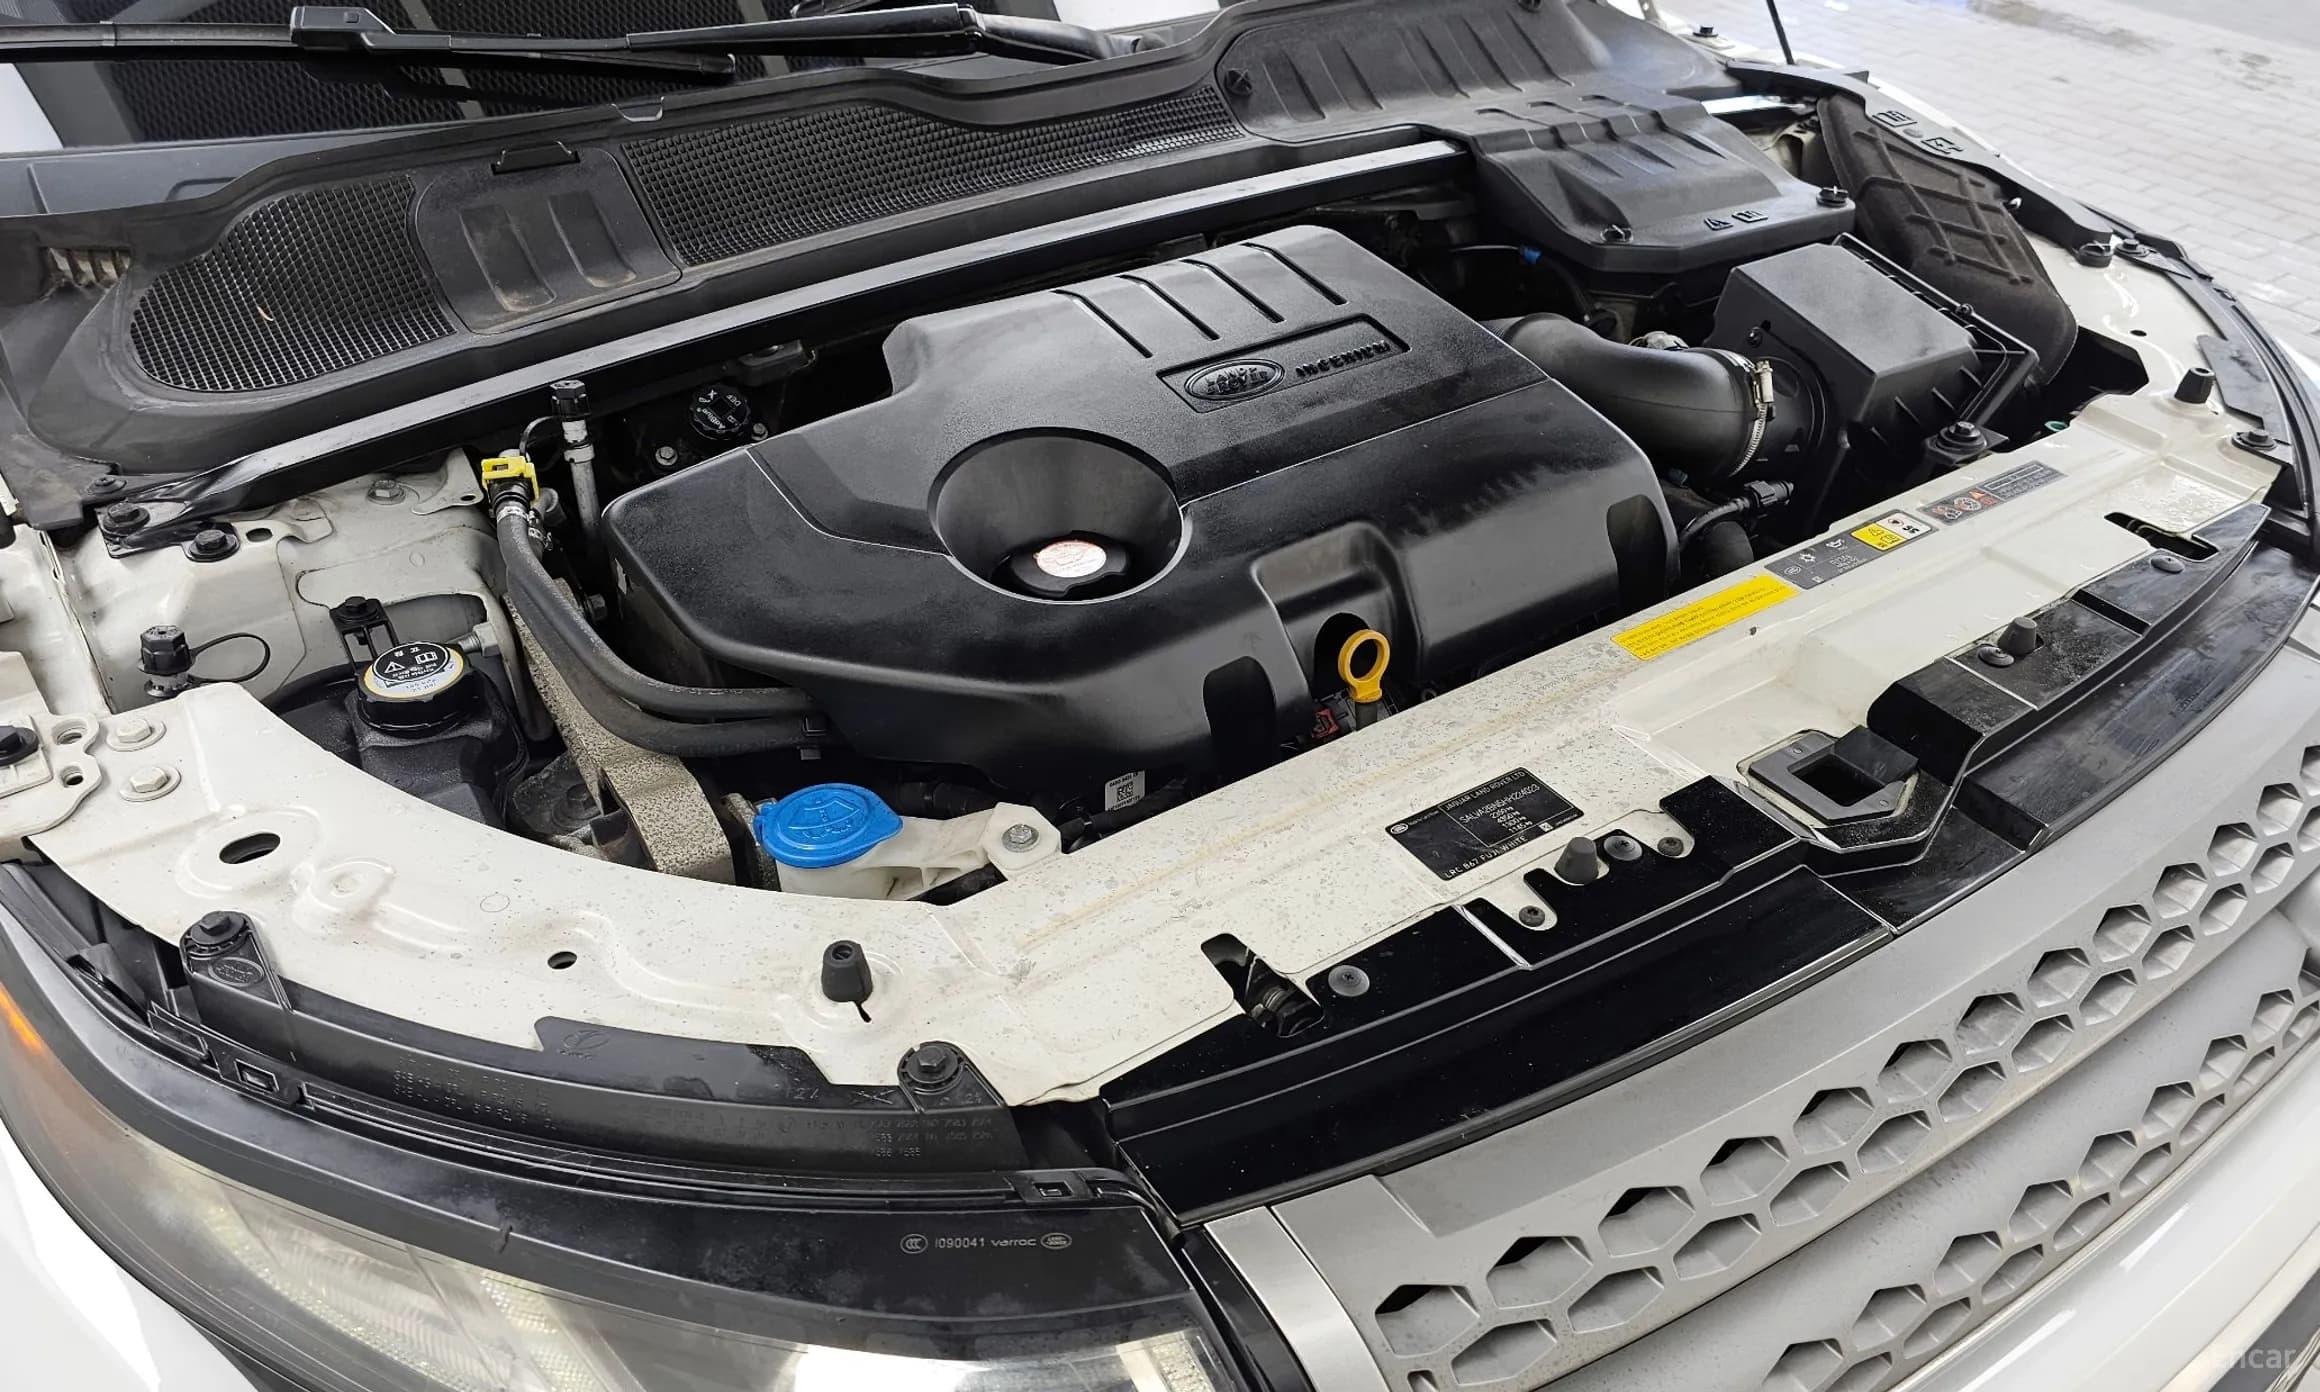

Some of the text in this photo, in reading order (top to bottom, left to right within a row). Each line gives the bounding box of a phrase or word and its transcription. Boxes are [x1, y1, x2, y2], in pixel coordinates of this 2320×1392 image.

[1471, 787, 1491, 798] LAND
[1512, 771, 1525, 780] LTD
[1445, 867, 1463, 878] LRC
[1499, 836, 1527, 852] WHITE
[990, 1239, 1037, 1247] varroc
